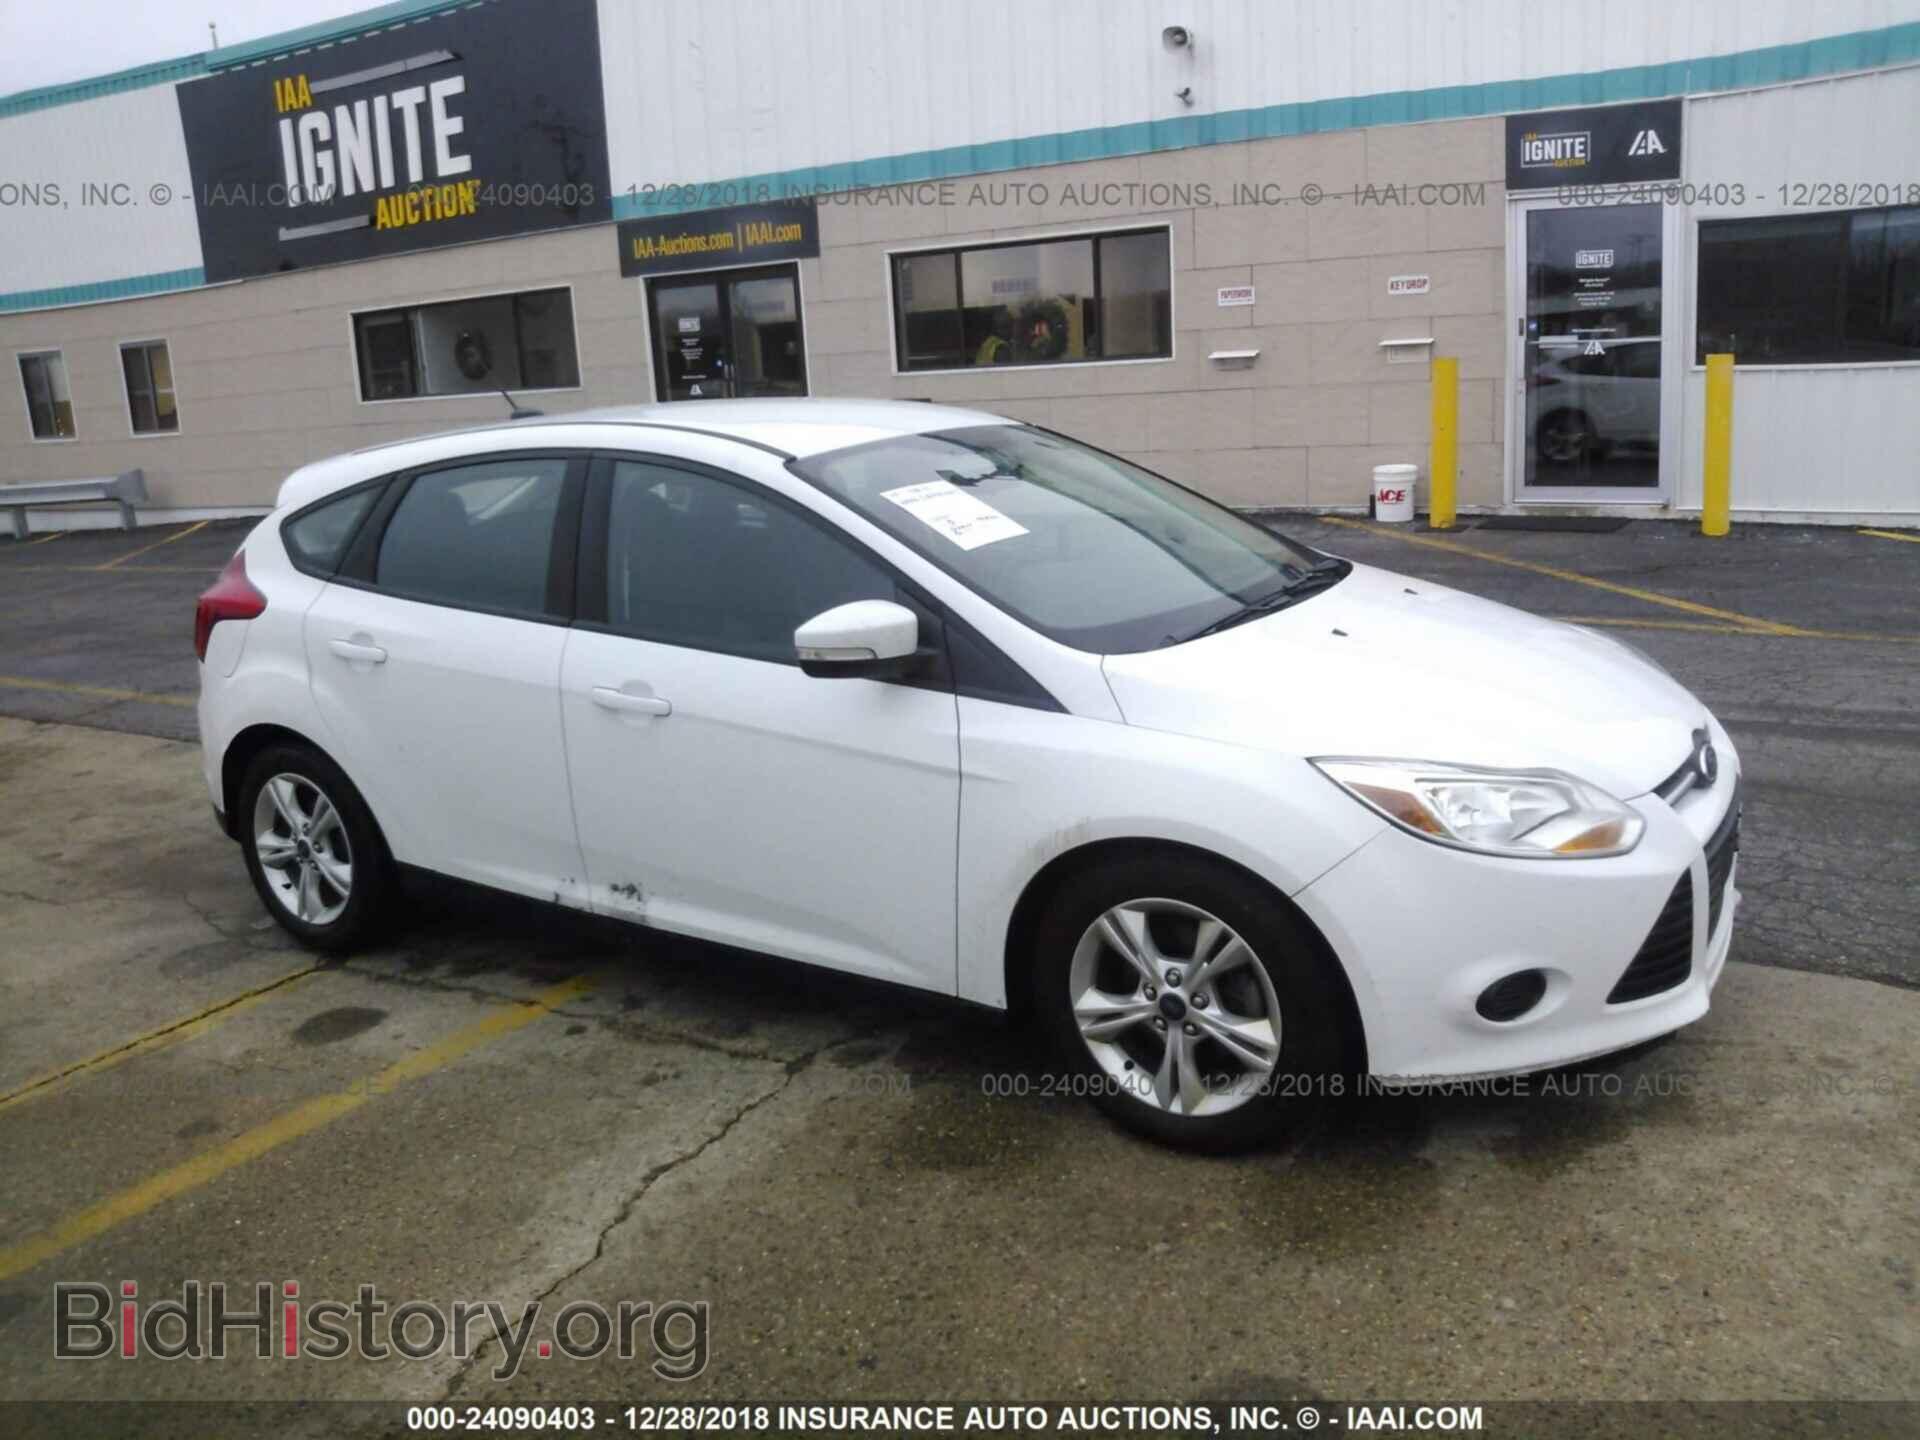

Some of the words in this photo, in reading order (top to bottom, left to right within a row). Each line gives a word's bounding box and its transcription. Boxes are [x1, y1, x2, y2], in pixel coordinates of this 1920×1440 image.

[273, 74, 313, 113] IAA
[279, 75, 472, 208] IGNITE
[1525, 137, 1586, 162] IGNITE
[633, 231, 734, 260] IAA-Auctions.com
[1578, 252, 1611, 266] IGNITE
[1377, 488, 1407, 503] ACE
